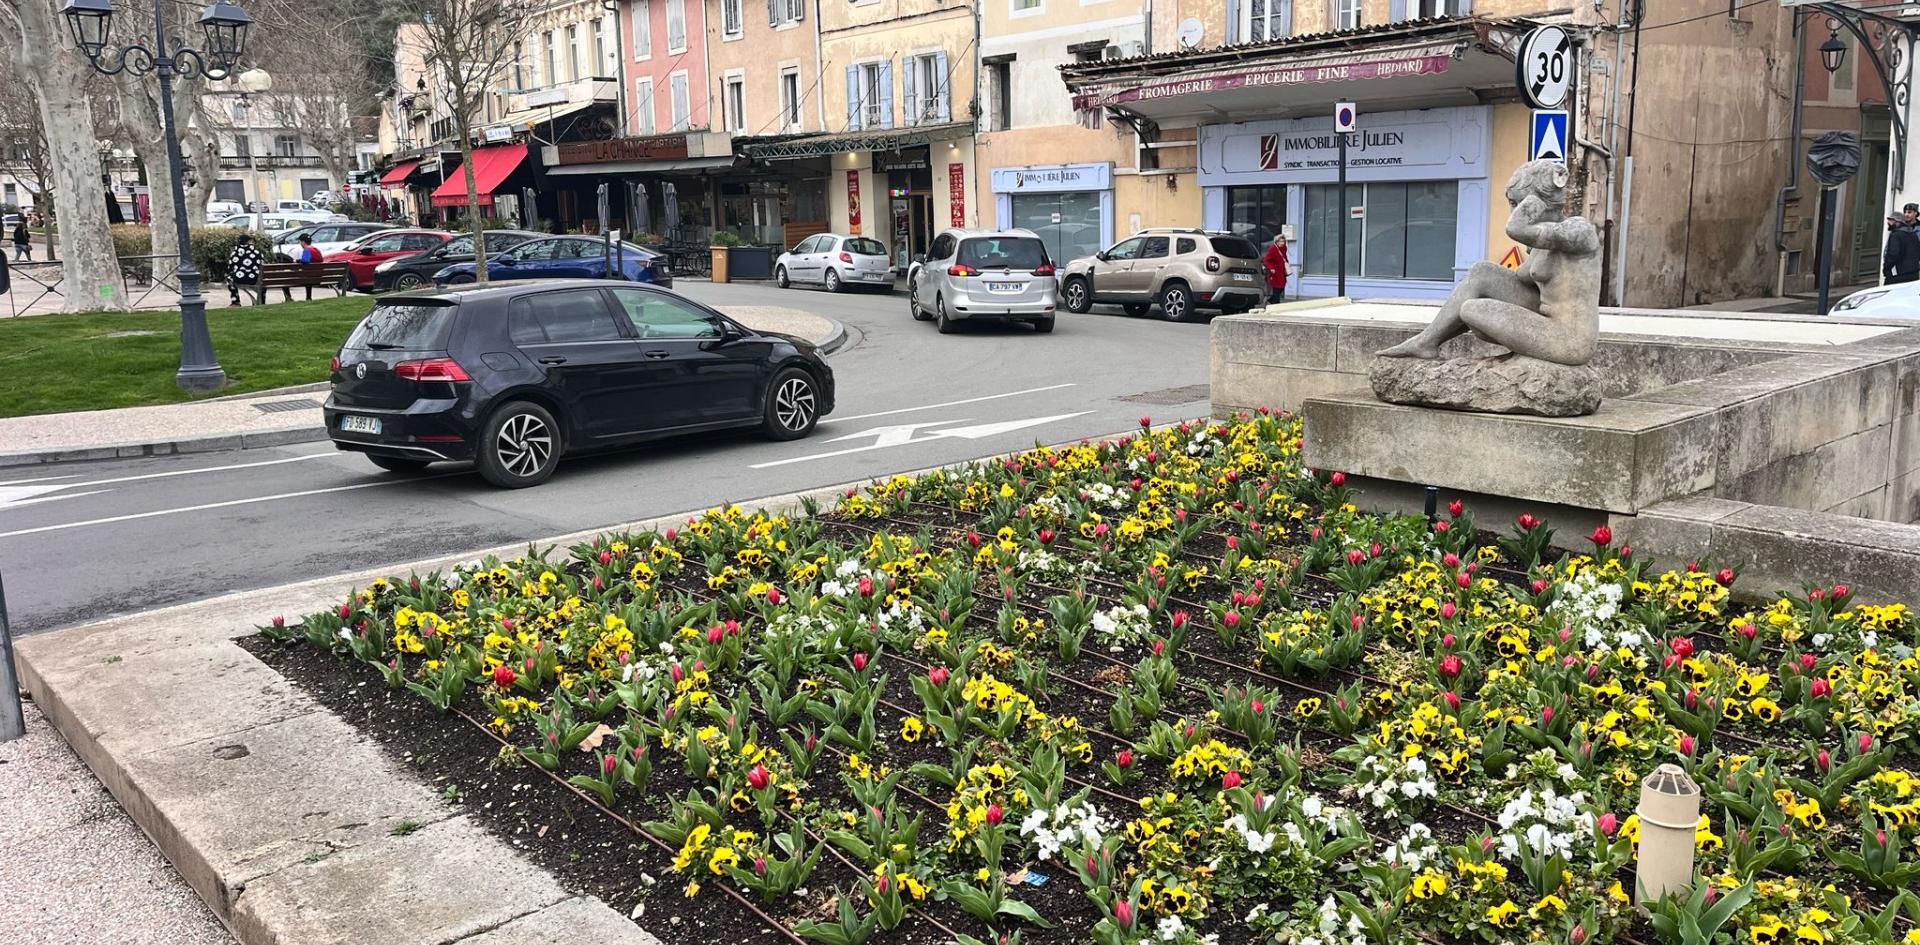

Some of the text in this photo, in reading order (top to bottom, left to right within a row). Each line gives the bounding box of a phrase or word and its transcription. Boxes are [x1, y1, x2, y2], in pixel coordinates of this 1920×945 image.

[1377, 59, 1423, 76] HEDIARD
[1537, 51, 1564, 83] 30
[1138, 66, 1350, 99] FROMAGERIE EPICERIE FINE
[1284, 134, 1360, 150] IMMOBILIRE
[1284, 157, 1403, 169] SYNDIC TRANSACTIO GESTION LOCATIVE
